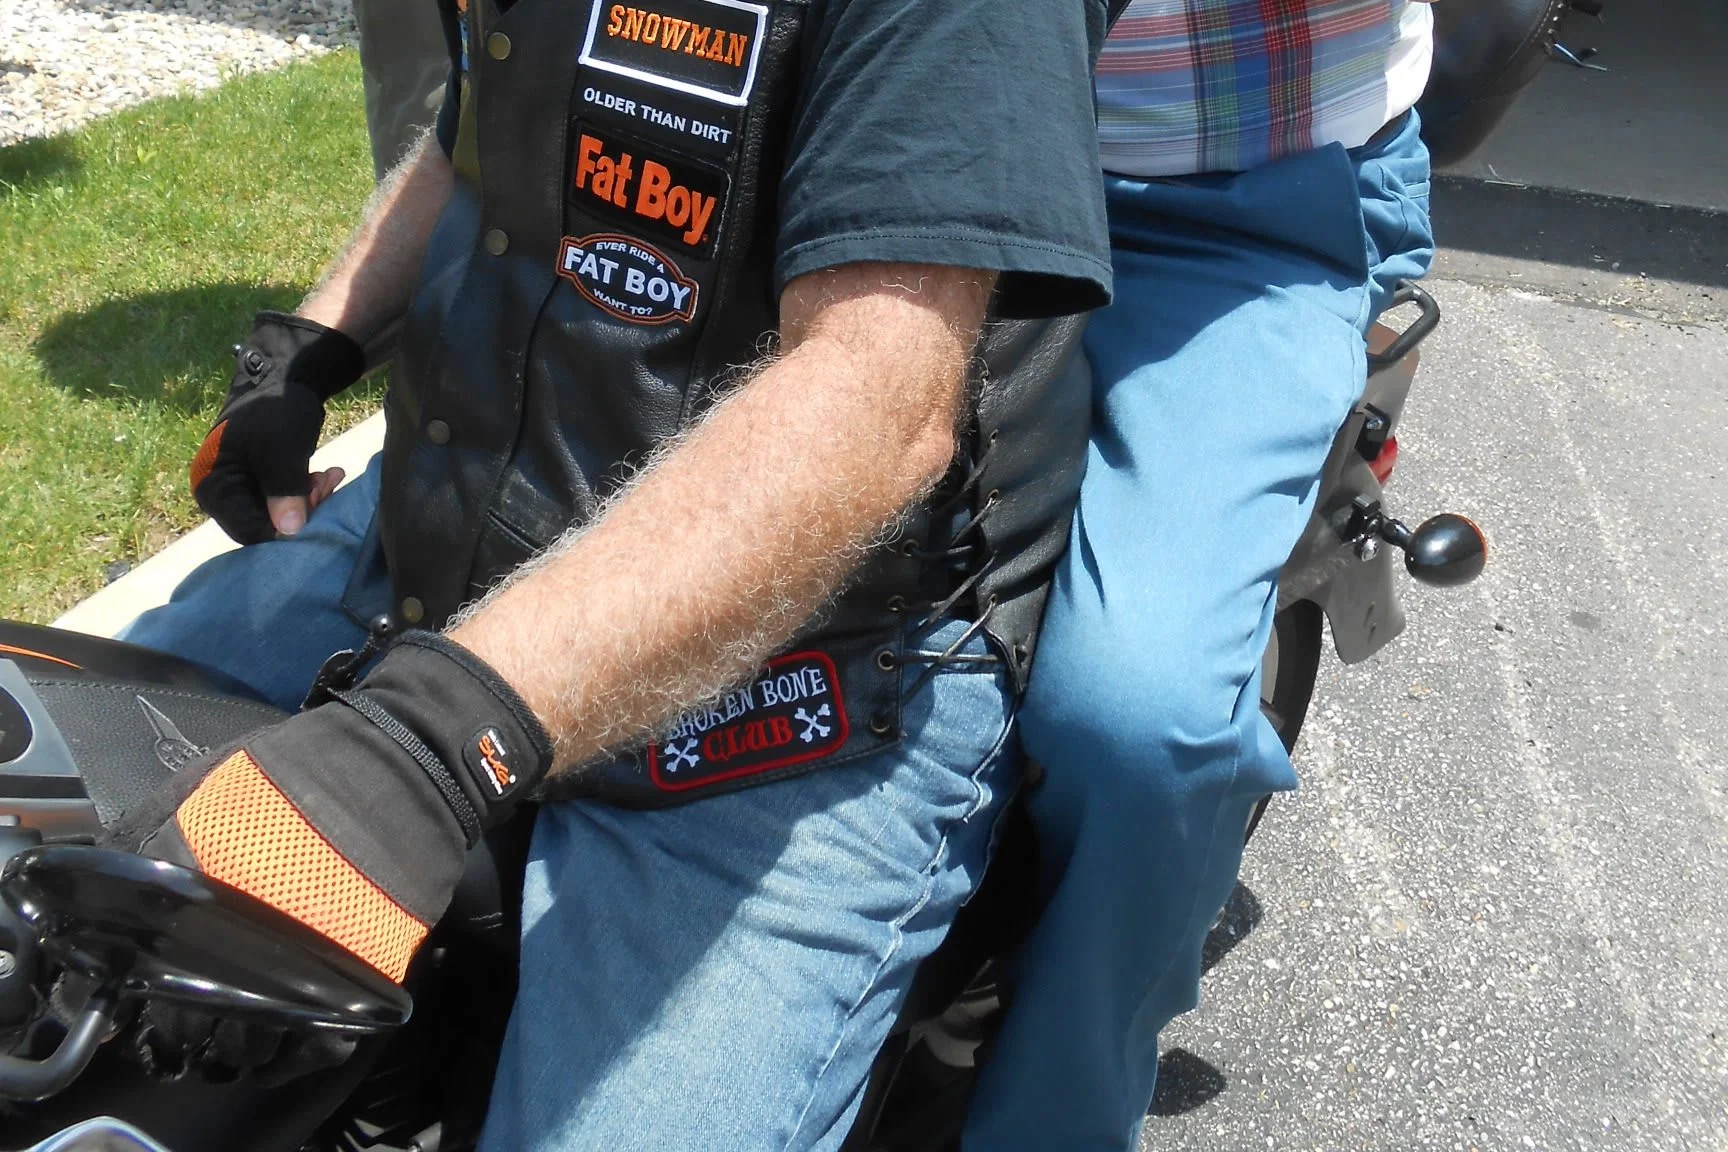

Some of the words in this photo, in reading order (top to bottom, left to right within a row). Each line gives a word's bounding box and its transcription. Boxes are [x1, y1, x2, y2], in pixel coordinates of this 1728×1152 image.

[607, 4, 748, 67] SNOWMAN
[584, 87, 636, 116] OLDER
[640, 106, 686, 132] THAN
[690, 120, 732, 144] DIRT
[575, 134, 633, 209] Fat
[635, 159, 718, 246] Boy
[564, 246, 619, 285] FAT
[624, 268, 691, 310] BOY
[596, 242, 627, 252] EVER
[629, 246, 656, 266] RIDE
[656, 263, 665, 274] A
[593, 288, 627, 311] WANT
[630, 306, 653, 316] TO?
[757, 666, 827, 708] BONE
[702, 716, 794, 763] CLUB
